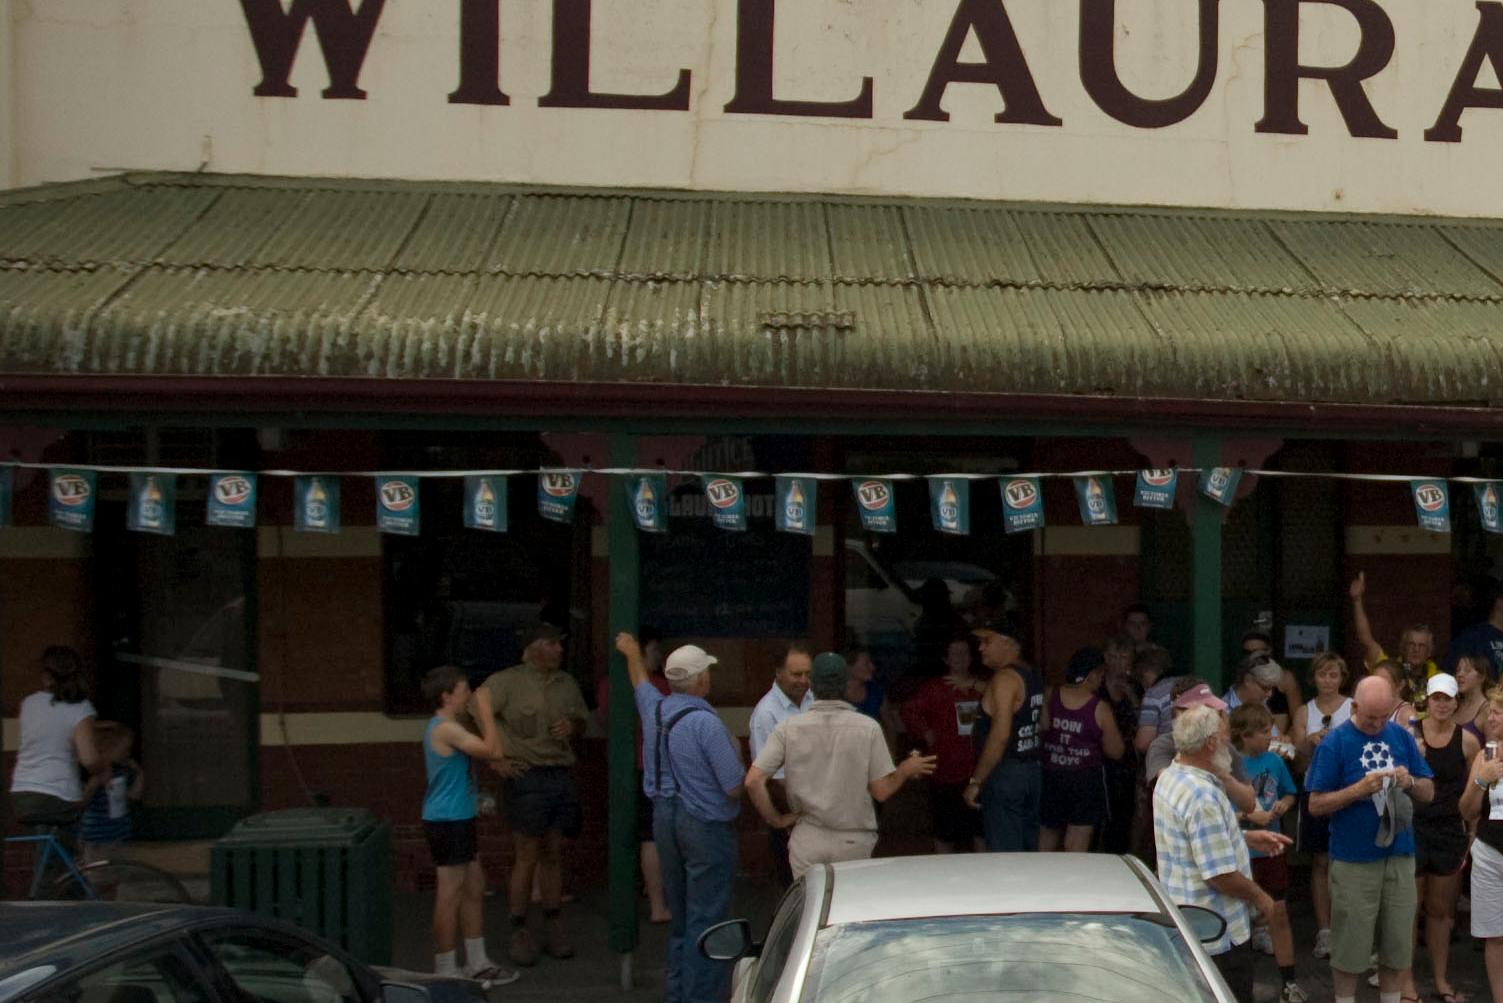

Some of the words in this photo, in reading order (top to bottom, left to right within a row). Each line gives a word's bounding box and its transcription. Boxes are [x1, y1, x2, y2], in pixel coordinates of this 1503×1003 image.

[57, 480, 89, 497] VB
[217, 480, 250, 497] VB
[547, 473, 573, 488] VB
[382, 486, 414, 503] VB
[709, 484, 736, 500] VB
[861, 484, 887, 501] VB
[1008, 482, 1034, 500] VB
[1418, 488, 1442, 504] VB
[1052, 717, 1082, 733] DOIN
[1060, 733, 1071, 745] IT
